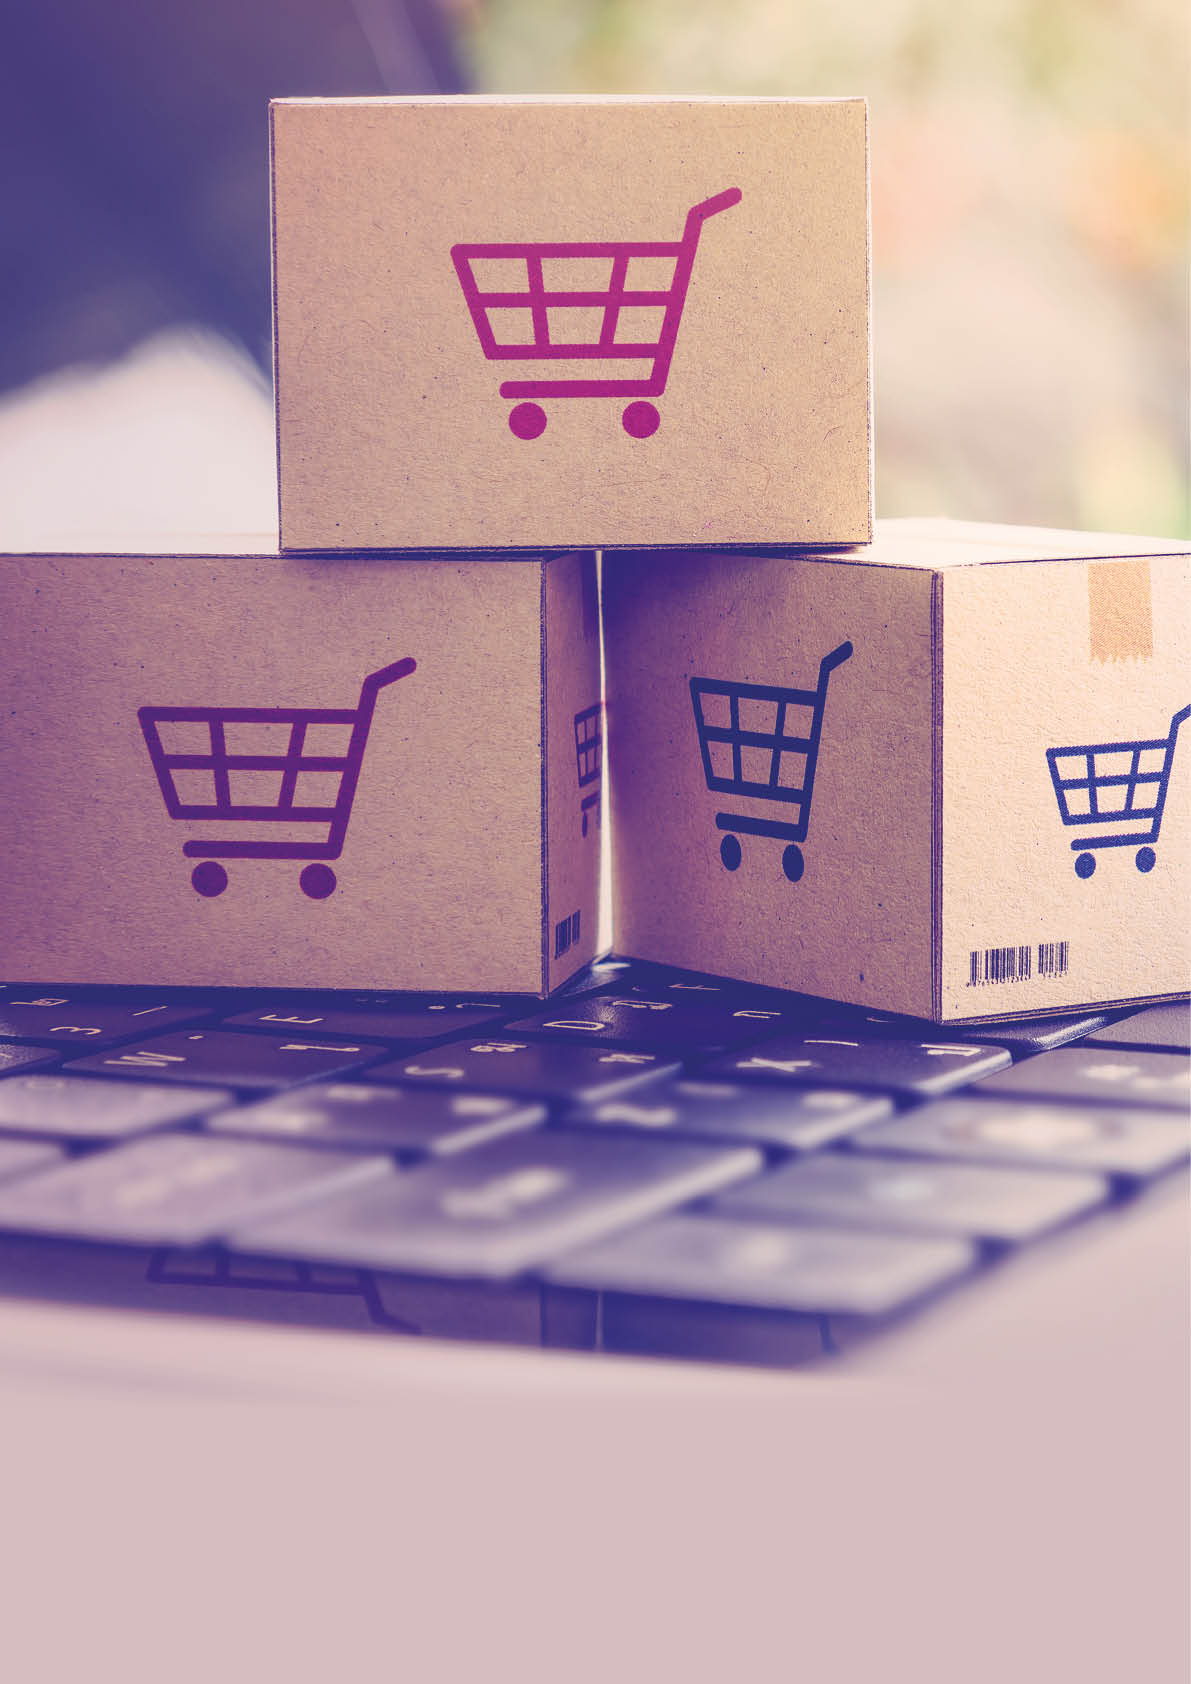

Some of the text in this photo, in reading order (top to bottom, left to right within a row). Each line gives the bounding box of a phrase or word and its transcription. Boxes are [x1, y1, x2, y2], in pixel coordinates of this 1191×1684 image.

[49, 1026, 102, 1036] 3
[103, 1051, 187, 1067] W
[735, 1056, 814, 1073] X
[404, 1065, 465, 1079] S
